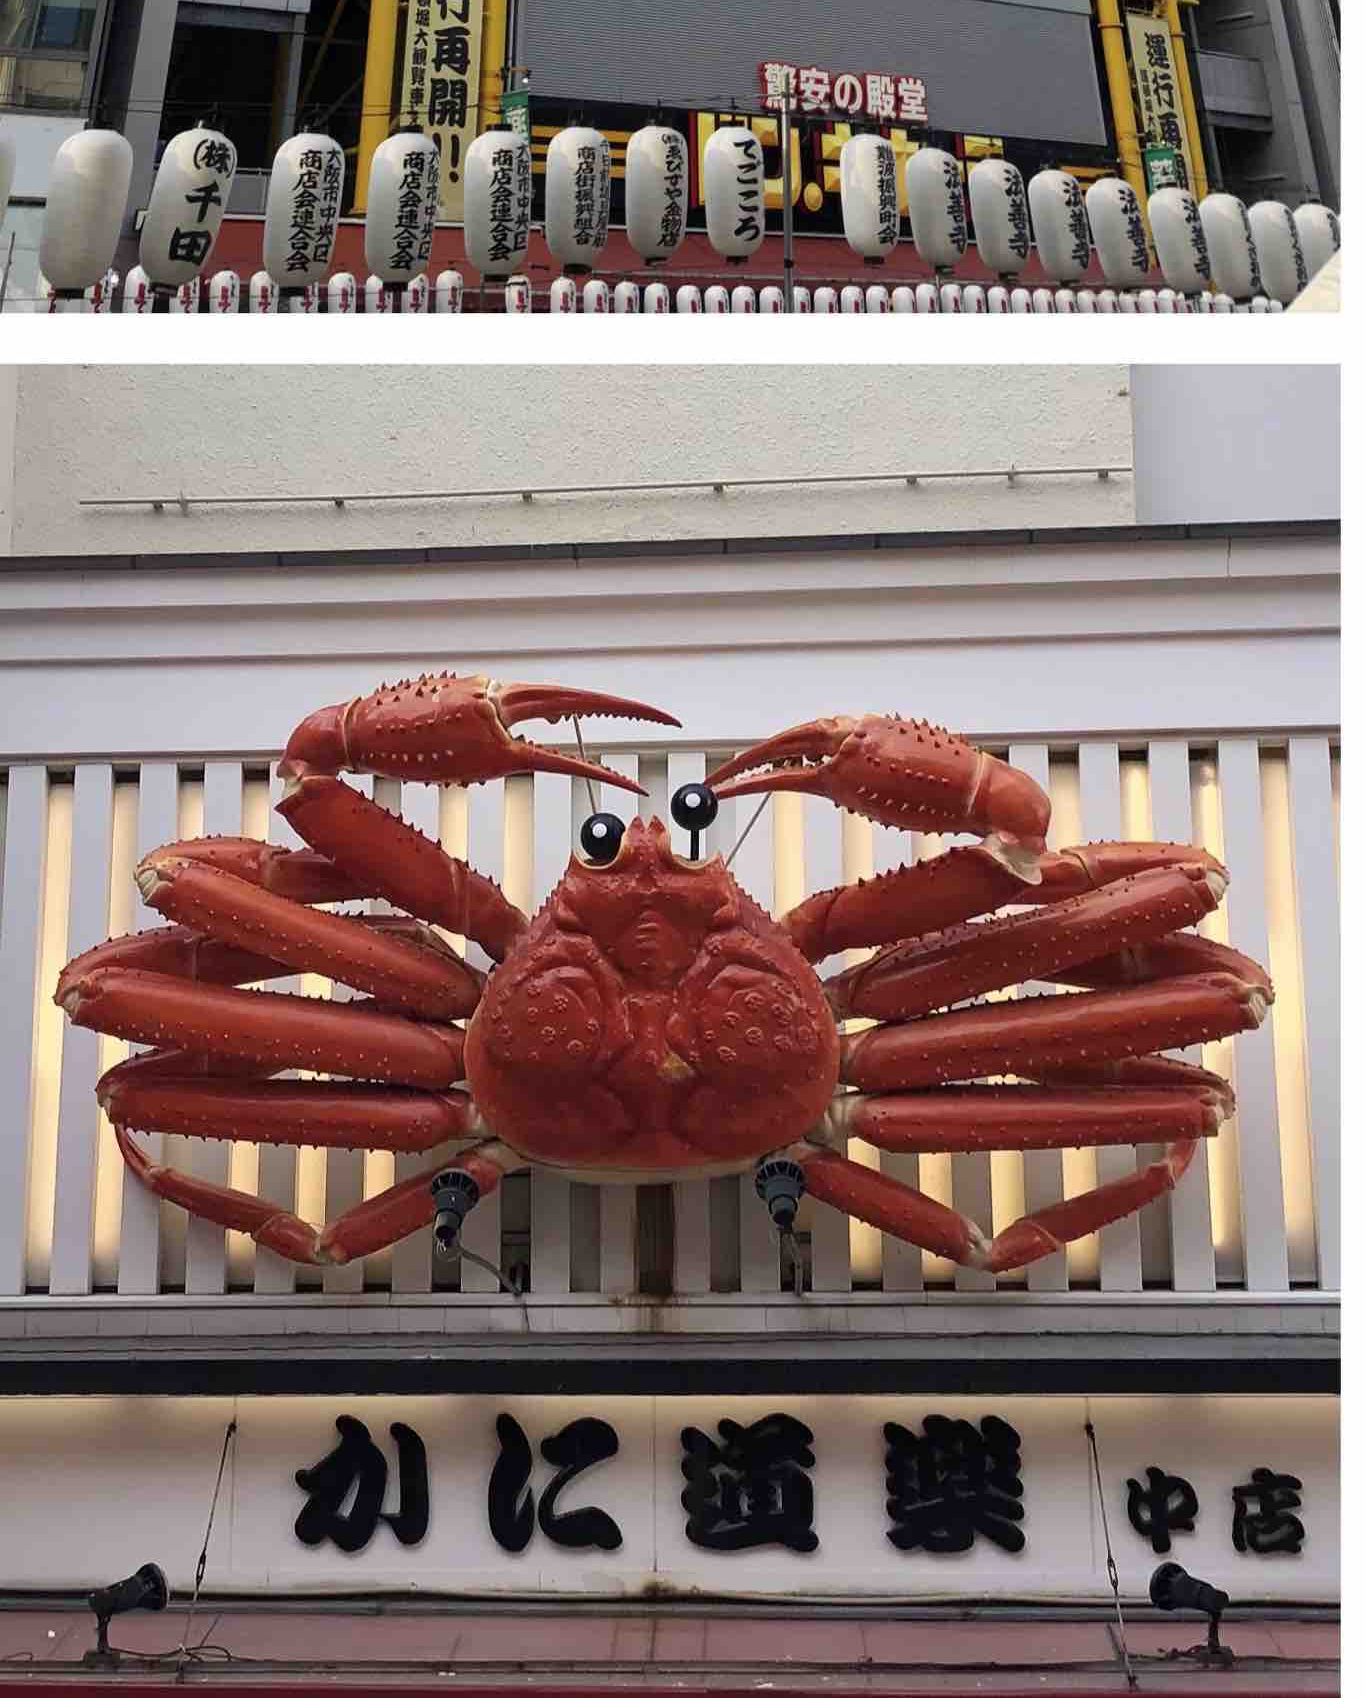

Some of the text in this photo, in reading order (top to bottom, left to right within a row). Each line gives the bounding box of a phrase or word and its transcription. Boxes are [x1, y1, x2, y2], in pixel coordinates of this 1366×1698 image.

[283, 149, 323, 272] 商店会連合会
[389, 150, 425, 271] 商店会連合会
[487, 149, 514, 262] 商店会連合会
[1126, 1465, 1306, 1554] 中店
